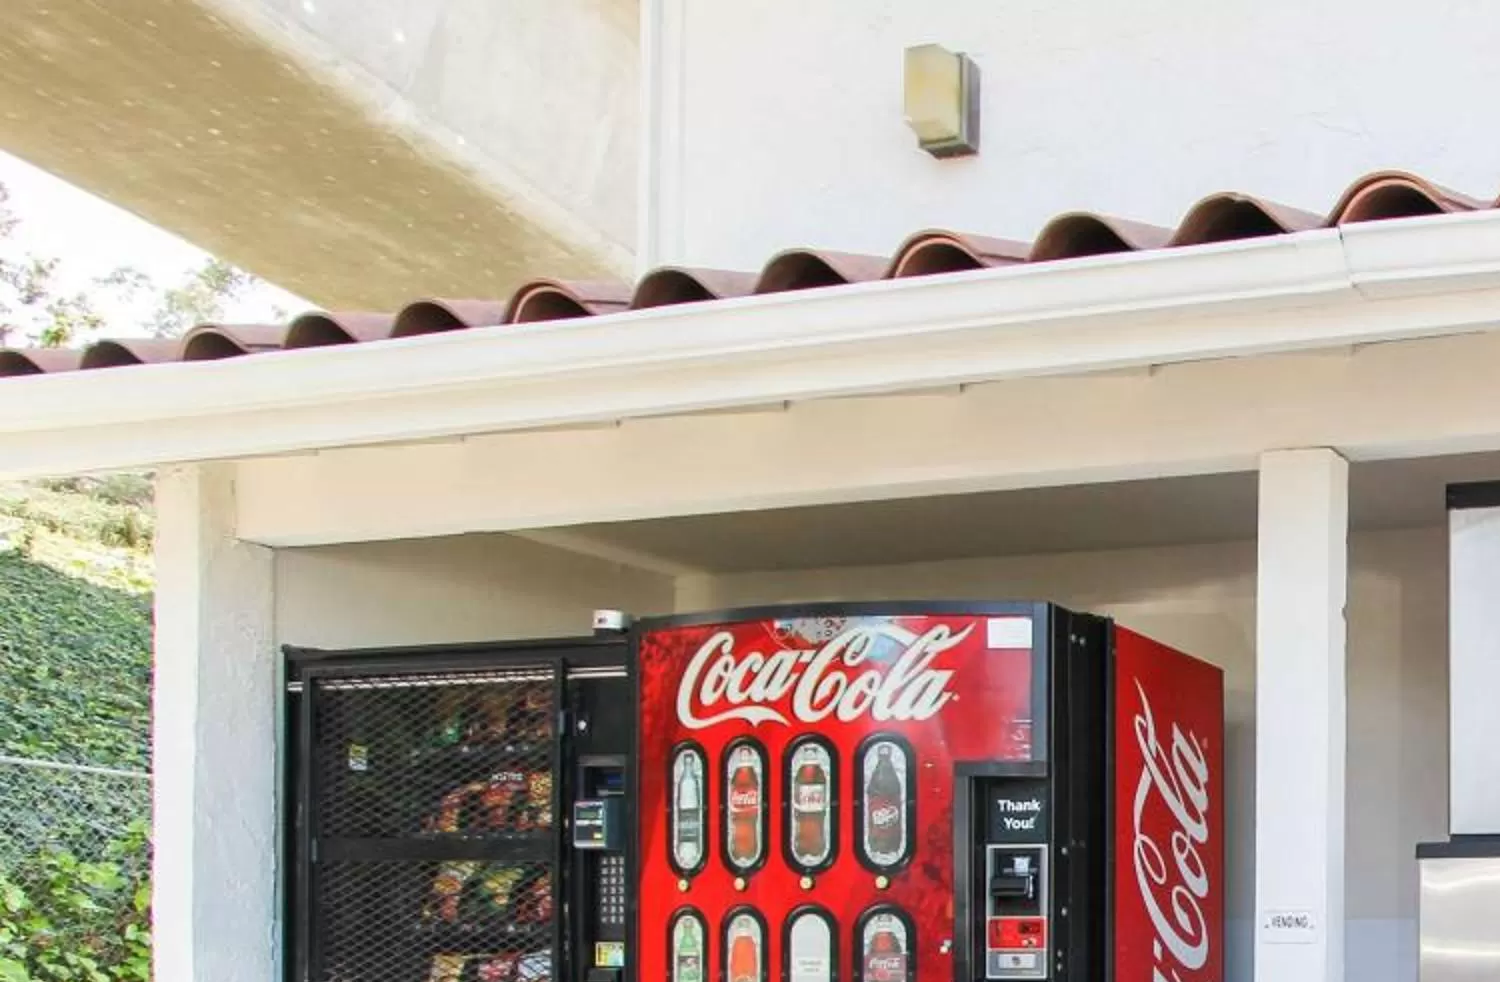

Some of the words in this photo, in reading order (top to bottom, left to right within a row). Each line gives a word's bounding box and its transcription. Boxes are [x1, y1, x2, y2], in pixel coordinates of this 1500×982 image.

[676, 621, 976, 729] Coca-Cola
[997, 799, 1041, 812] Thank
[1271, 914, 1309, 929] VENDING
